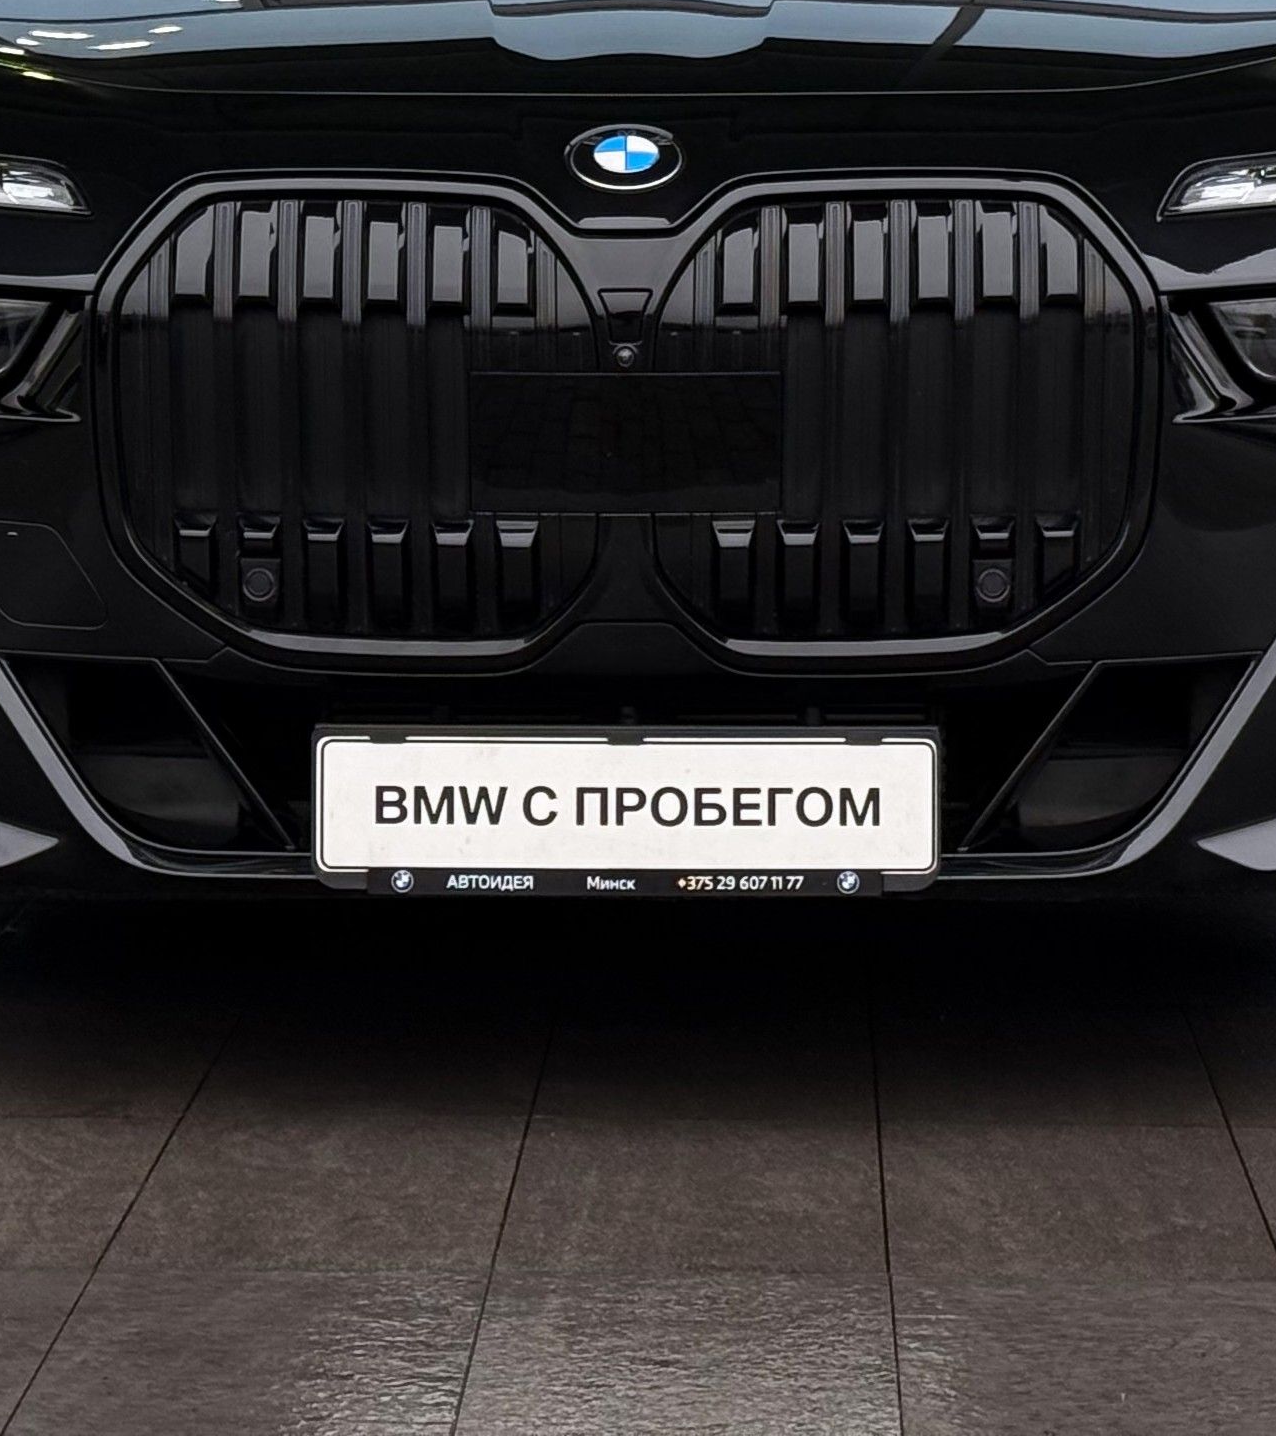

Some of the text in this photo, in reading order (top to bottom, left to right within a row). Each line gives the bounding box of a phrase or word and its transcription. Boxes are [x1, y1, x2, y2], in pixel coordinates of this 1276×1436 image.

[374, 785, 881, 828] BMW С ПРОБЕГОМ
[446, 874, 805, 892] АВТОИДЕЯ Минск +375 29 607 11 77
